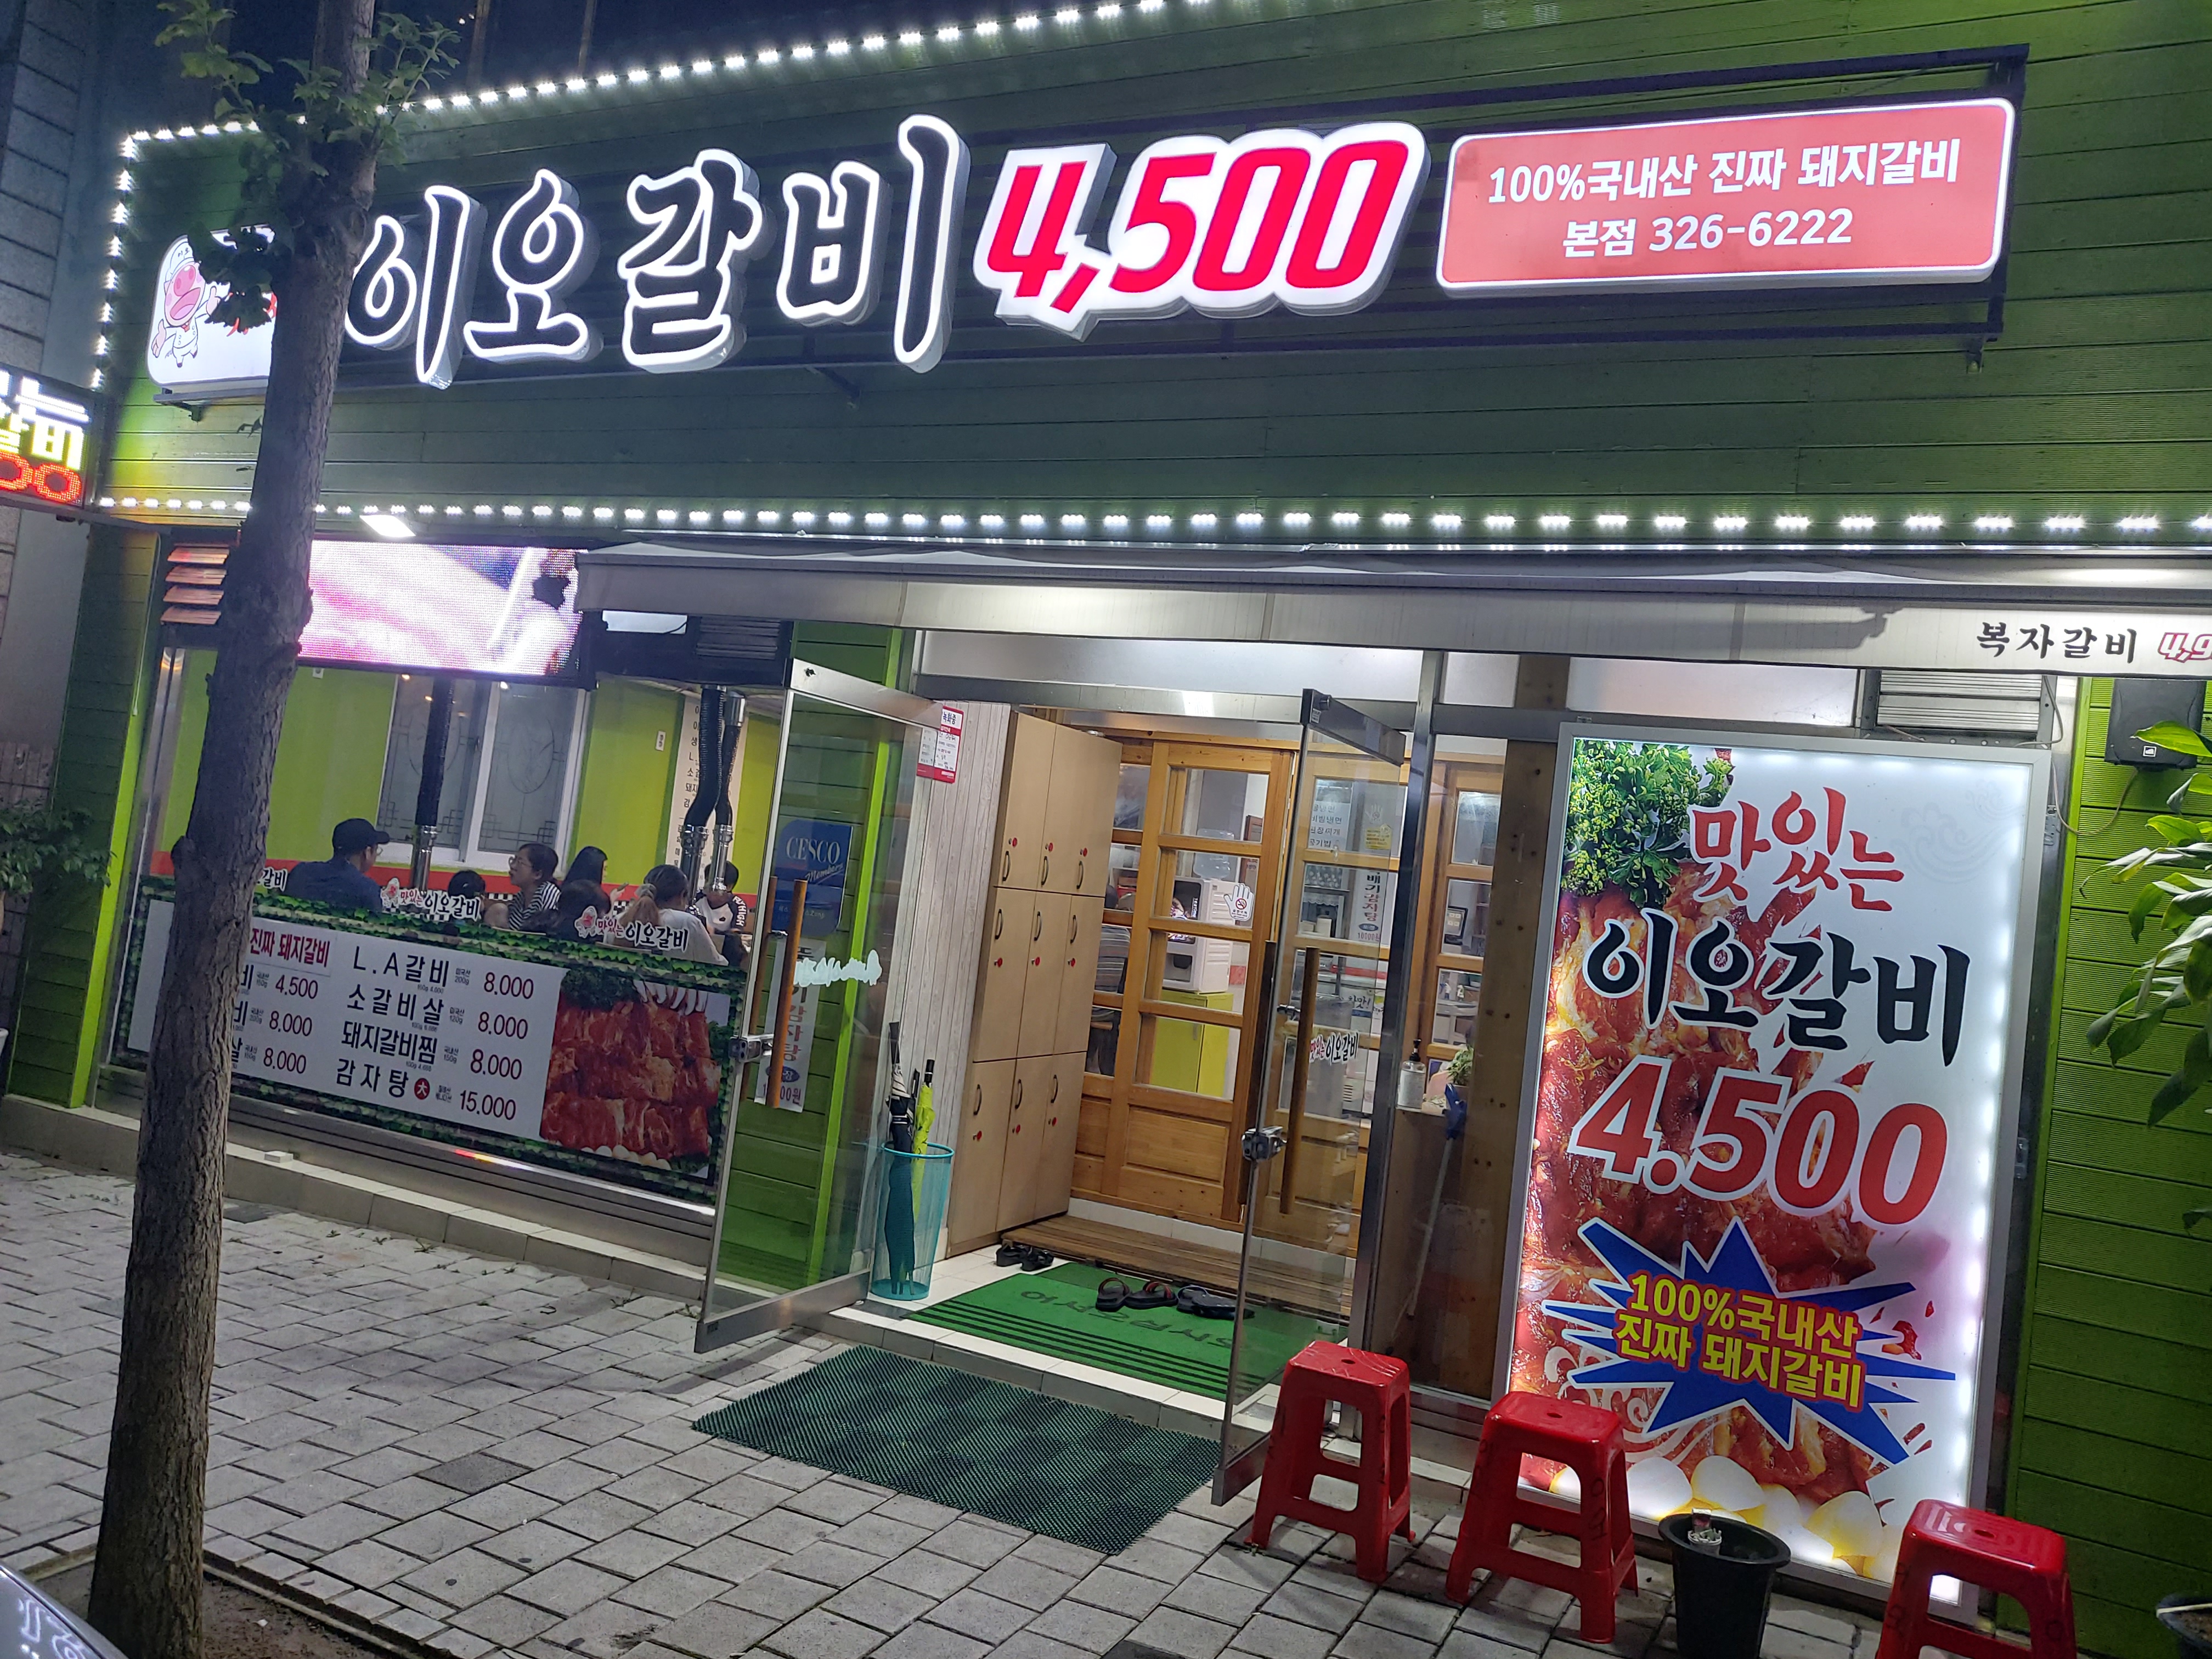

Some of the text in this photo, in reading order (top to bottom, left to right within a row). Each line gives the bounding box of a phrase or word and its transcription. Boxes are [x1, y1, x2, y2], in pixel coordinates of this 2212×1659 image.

[1488, 138, 1961, 204] 100%국내산 진짜 돼지갈비
[988, 139, 1409, 314] 4,500
[1562, 207, 1853, 258] 본점 326-6222
[346, 115, 957, 385] 이오갈비
[1977, 622, 2137, 663] 복자갈비
[786, 837, 840, 865] CESCO
[1691, 787, 1905, 912] 맛있는
[400, 891, 481, 919] 맛있는 이오갈비
[250, 928, 330, 968] 진짜 돼지갈비
[597, 918, 688, 951] 맛있는 이오갈비
[276, 974, 319, 1000] 4.500
[455, 976, 469, 985] 200g
[484, 972, 534, 1000] 8.000
[1587, 911, 1971, 1067] 이오갈비
[269, 1011, 313, 1037] 8.000
[449, 1015, 463, 1025] 120g
[478, 1011, 528, 1040] 8.000
[263, 1047, 307, 1074] 8.000
[341, 1020, 437, 1065] 돼지갈비찜
[470, 1049, 522, 1080] 8.000
[444, 1053, 457, 1064] 150g
[1311, 1032, 1359, 1063] 맛있는 이오갈비
[336, 1058, 409, 1098] 감자탕
[460, 1090, 516, 1120] 15.000
[1576, 1062, 1948, 1225] 4.500
[1630, 1275, 1858, 1358] 100%국내산
[1616, 1313, 1862, 1408] 진짜 돼지갈비
